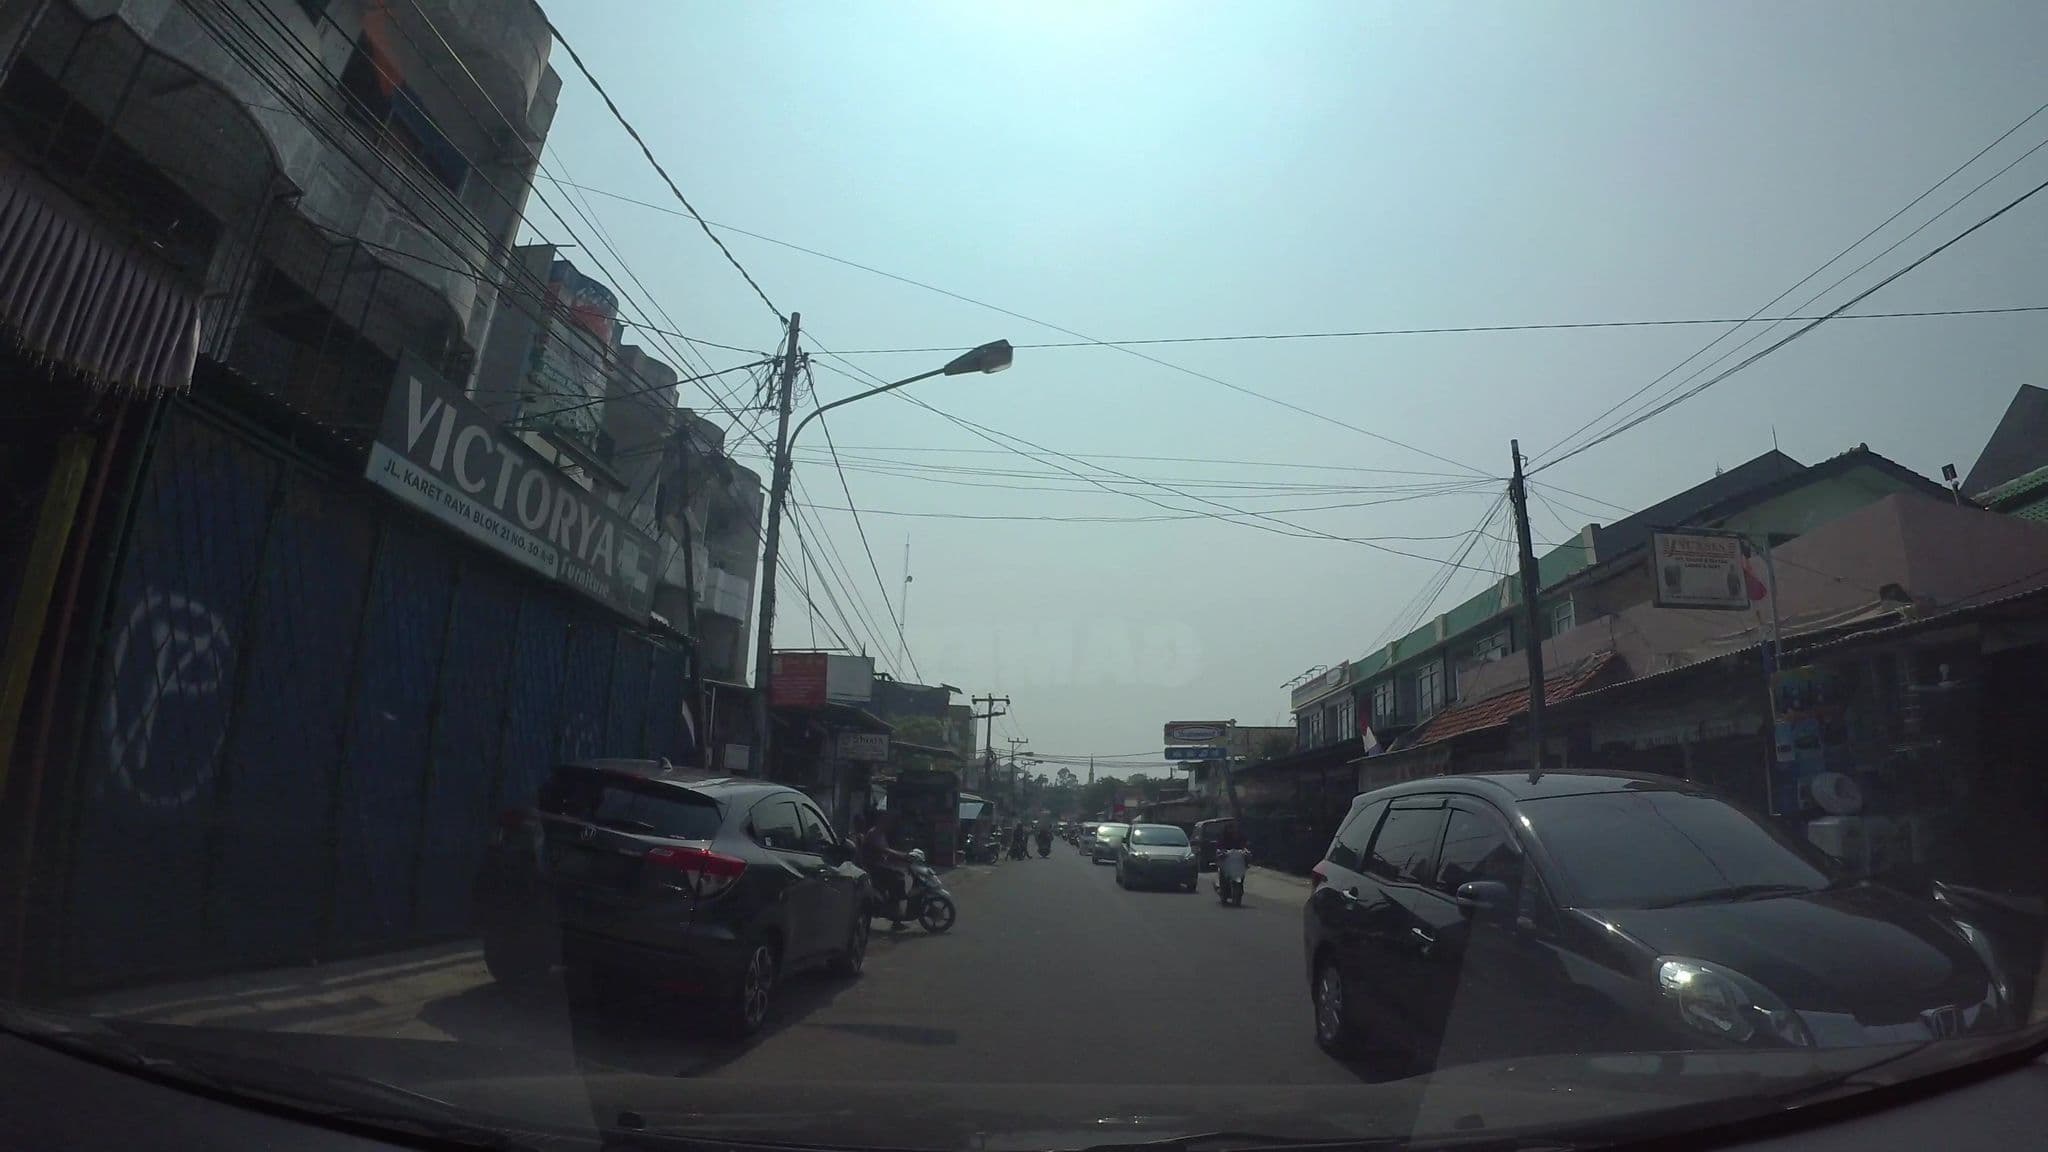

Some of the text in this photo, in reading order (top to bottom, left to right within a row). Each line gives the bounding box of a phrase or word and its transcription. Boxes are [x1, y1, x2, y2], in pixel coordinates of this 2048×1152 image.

[383, 458, 400, 479] JL.
[404, 469, 442, 501] KARET
[444, 494, 471, 518] RAYA
[473, 511, 500, 535] BLOK
[500, 526, 510, 541] 21
[527, 542, 540, 556] 30
[407, 376, 614, 577] VICTORYA
